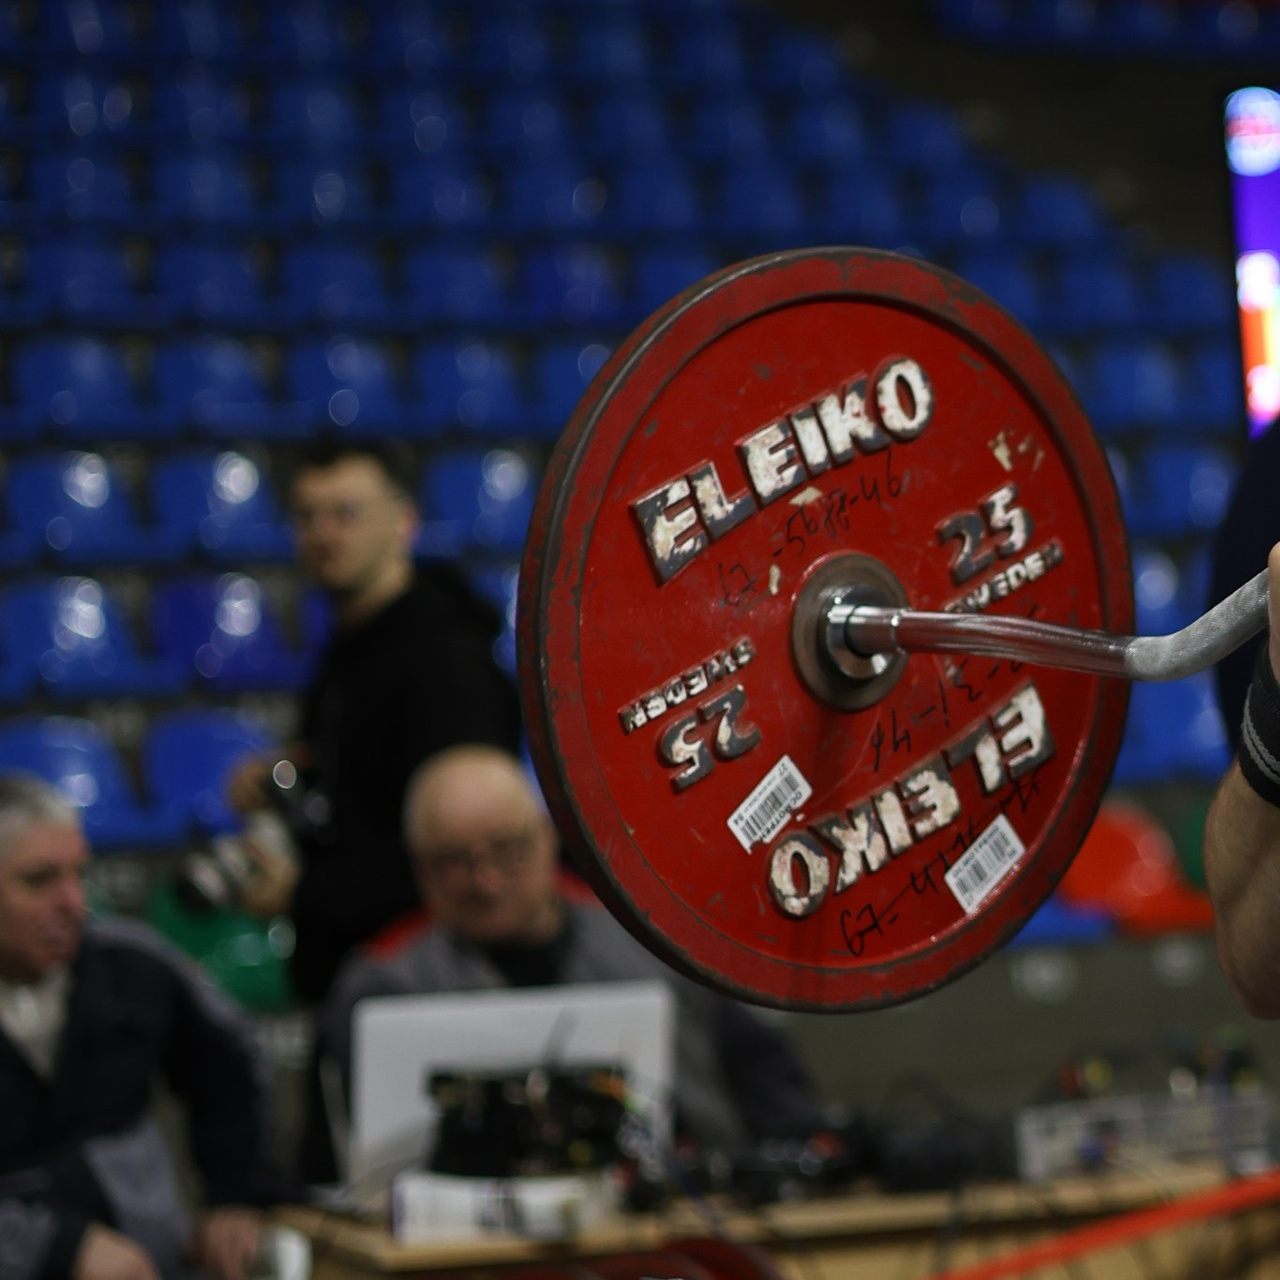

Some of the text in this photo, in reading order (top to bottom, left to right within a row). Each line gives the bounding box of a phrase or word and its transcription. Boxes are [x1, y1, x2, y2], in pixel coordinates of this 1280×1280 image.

[630, 356, 935, 584] ELEIKO
[937, 483, 1033, 584] 25
[942, 542, 1064, 614] SWEDEN
[620, 636, 755, 735] SWEDEN
[658, 684, 762, 791] 25
[757, 790, 805, 842] ОСМОТРЕН
[768, 682, 1055, 917] ELEIKO
